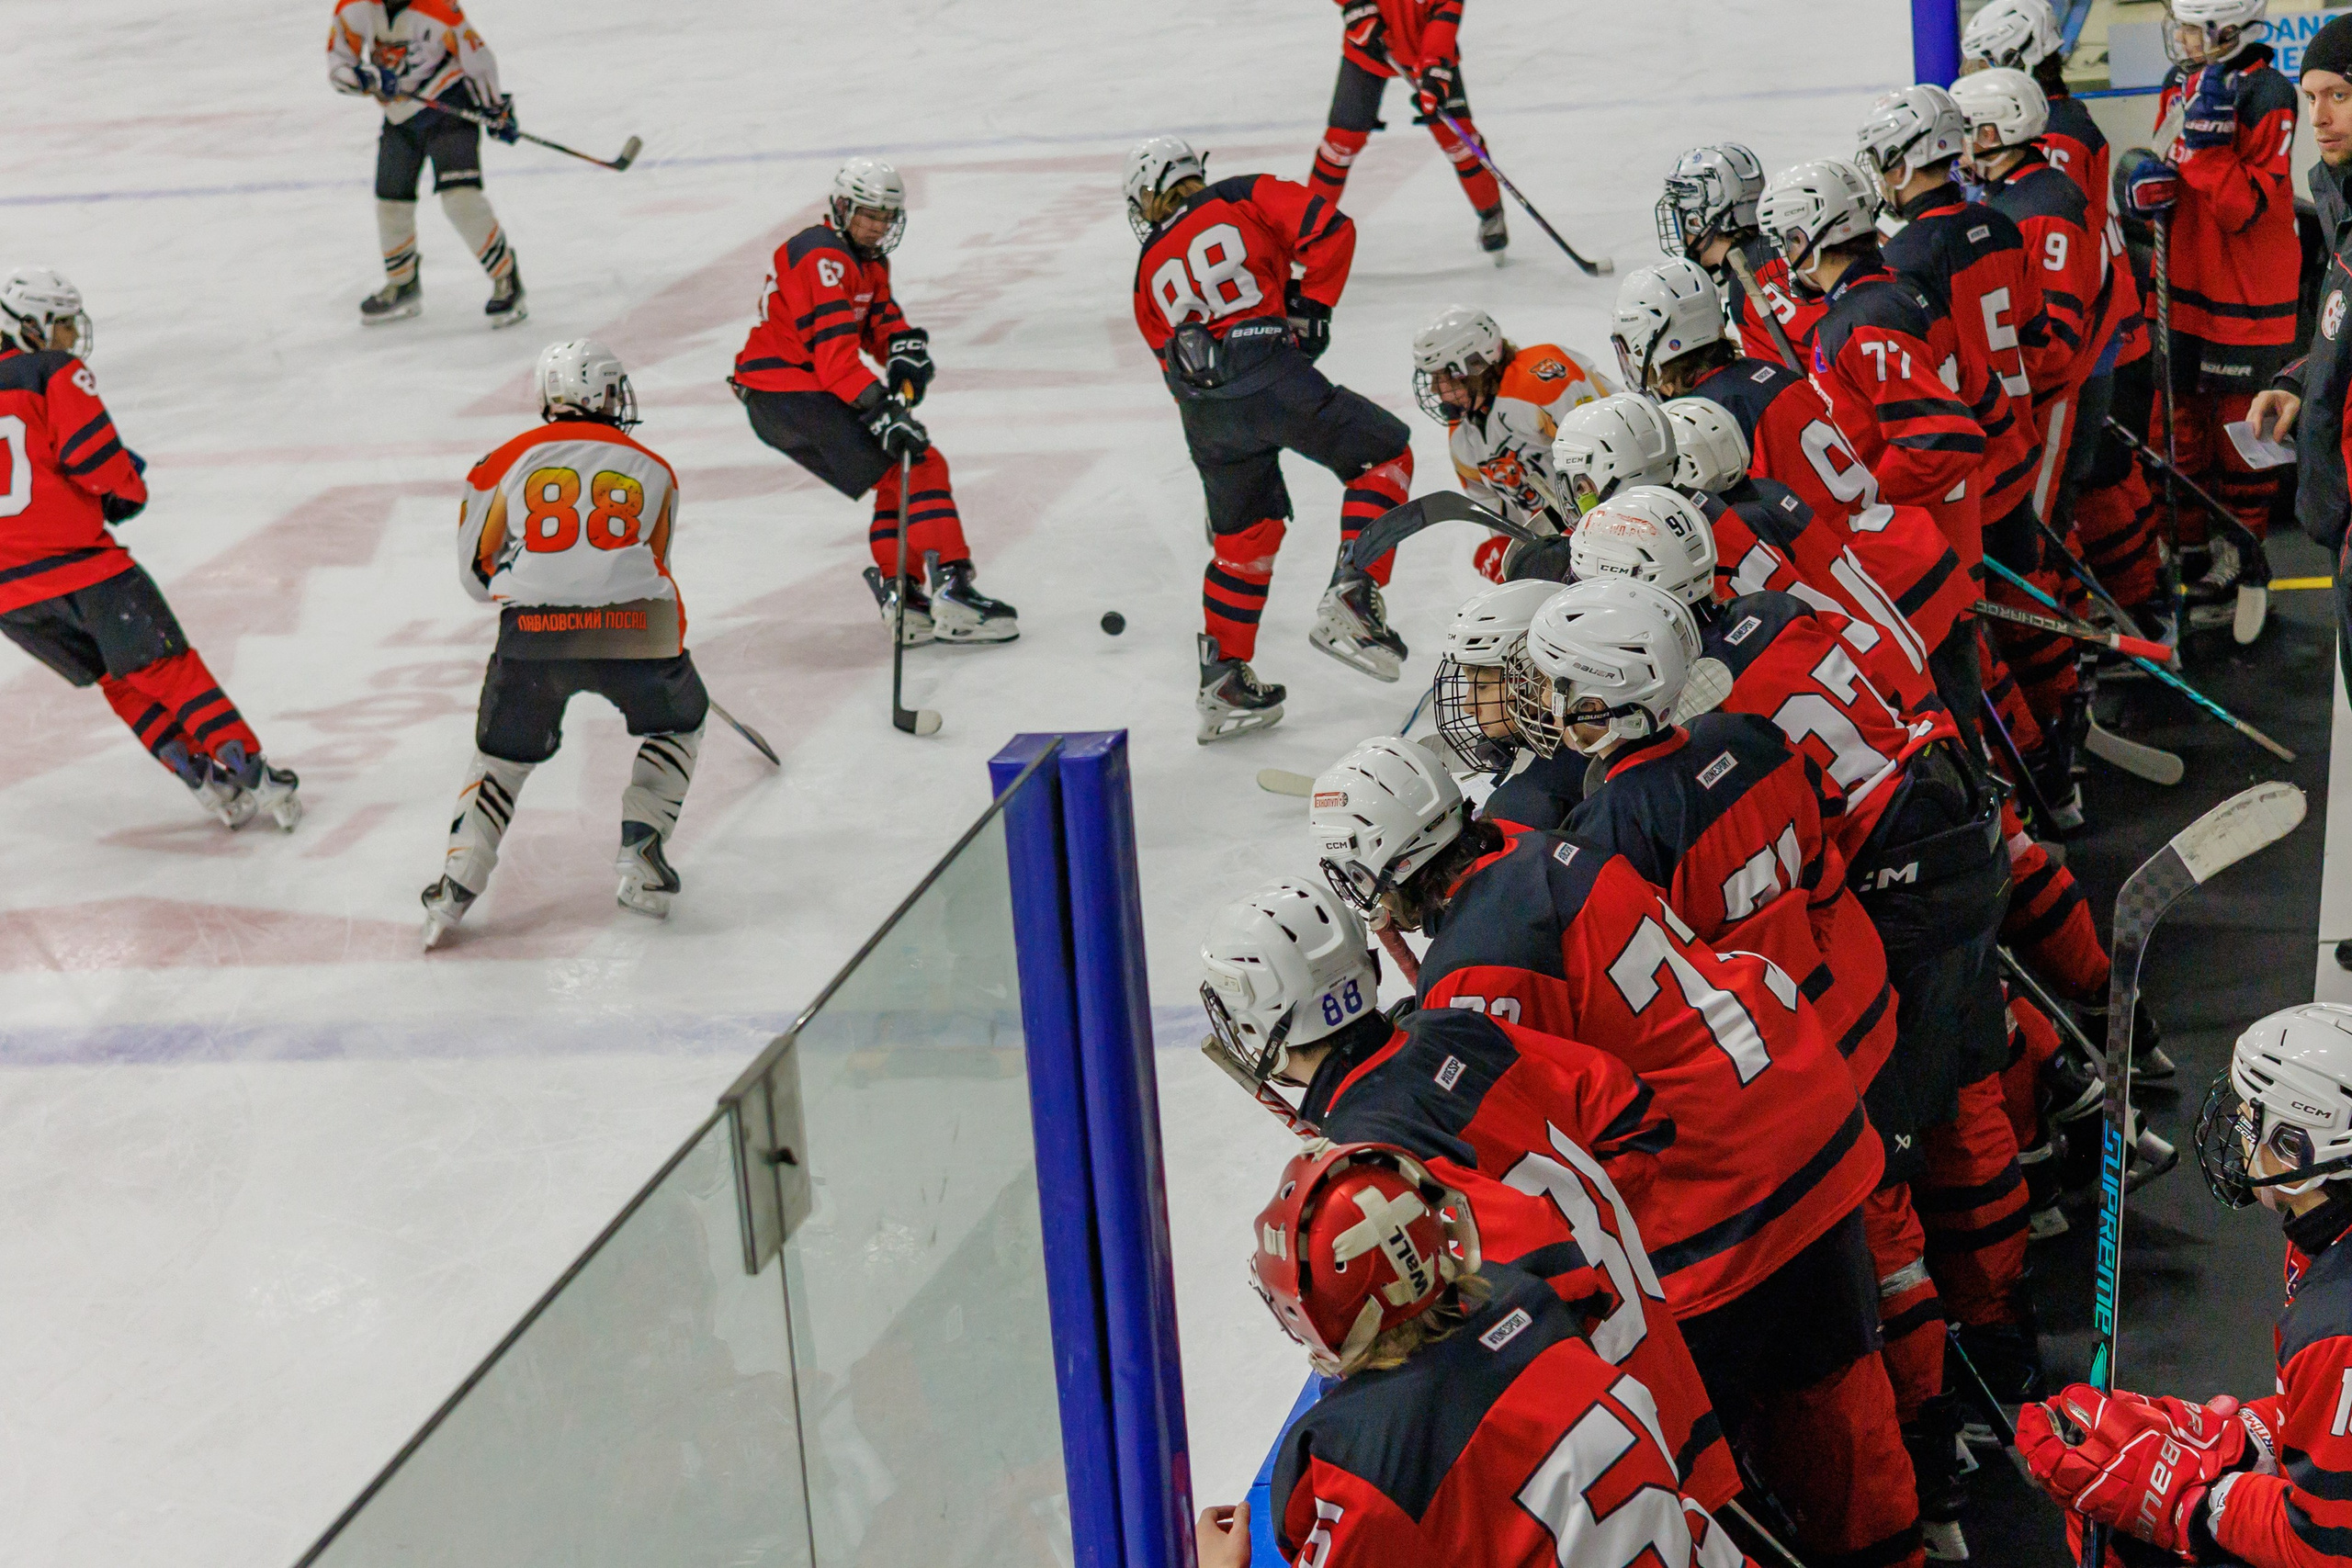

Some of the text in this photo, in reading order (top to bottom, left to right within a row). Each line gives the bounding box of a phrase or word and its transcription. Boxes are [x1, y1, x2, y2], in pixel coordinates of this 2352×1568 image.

[1783, 206, 1805, 217] CCM
[2043, 232, 2068, 271] 9
[891, 338, 926, 354] CC
[1565, 456, 1584, 465] CCM
[525, 467, 644, 553] 88
[1665, 510, 1693, 537] 97
[1600, 563, 1630, 575] CCM
[517, 608, 647, 632] ПАВЛОВСКИЙ ПОСАД
[1572, 660, 1616, 681] BAUER
[1577, 712, 1611, 722] BAUER
[1326, 840, 1348, 851] CCM
[1372, 892, 1382, 906] CCM
[1321, 978, 1363, 1027] 88
[2290, 1100, 2332, 1119] CCM
[2234, 1124, 2256, 1145] CCM
[2094, 1119, 2122, 1337] SUPREME
